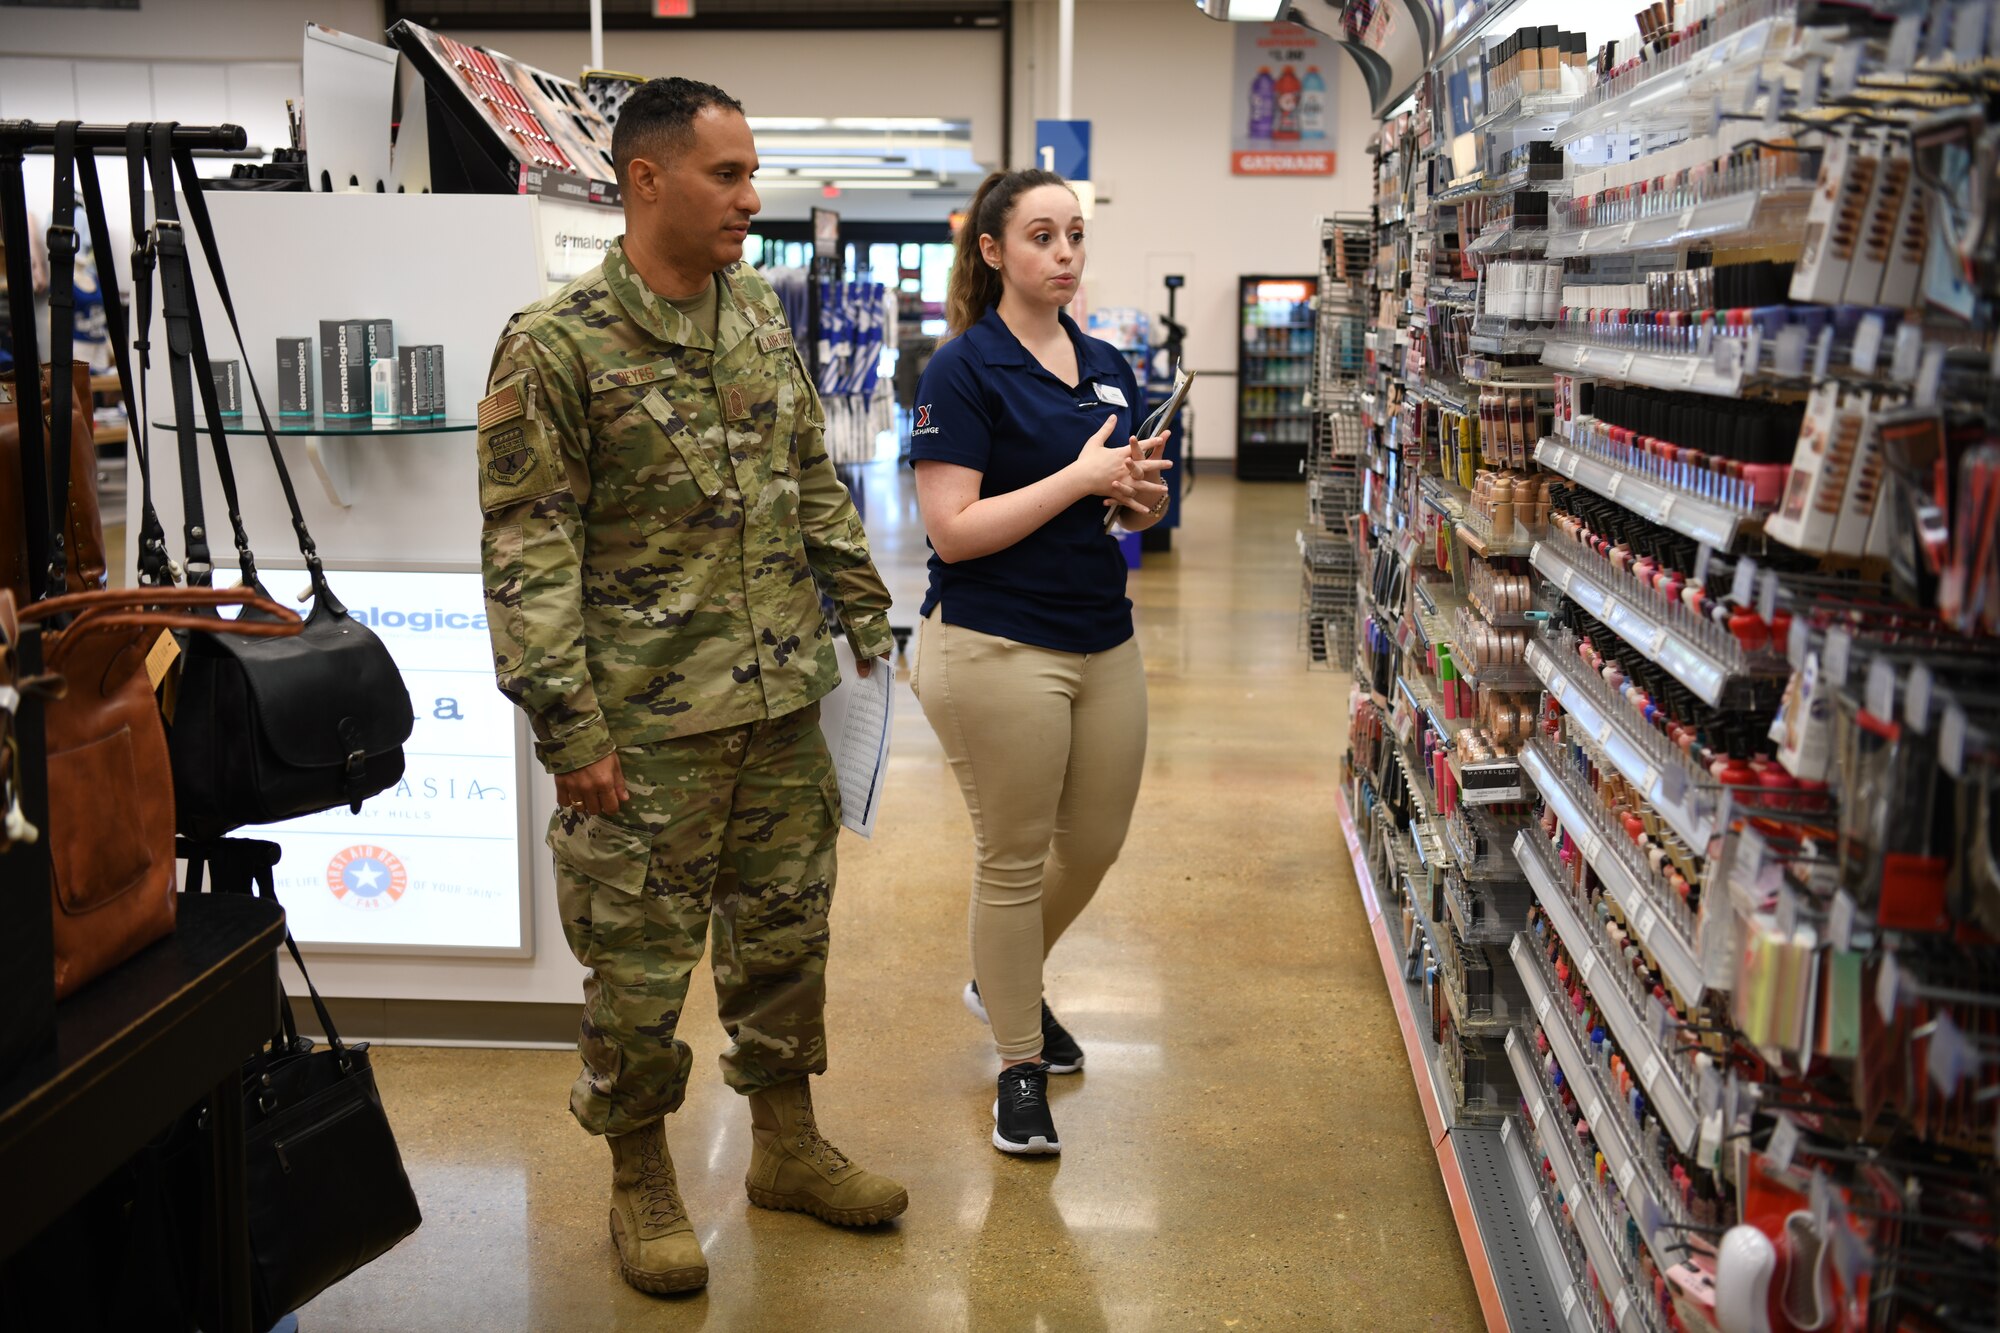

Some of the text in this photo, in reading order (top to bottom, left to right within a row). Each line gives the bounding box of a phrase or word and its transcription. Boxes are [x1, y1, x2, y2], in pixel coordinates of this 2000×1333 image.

[1040, 146, 1055, 172] 1
[1240, 155, 1328, 171] GATORADE
[555, 232, 612, 252] dermalog
[297, 342, 307, 411] dermalogica
[338, 325, 349, 413] dermalogica
[618, 367, 656, 384] REYES
[410, 351, 418, 415] dermalogica
[912, 427, 940, 437] EXCHANGE
[389, 810, 432, 819] HILLS
[330, 845, 404, 894] FIRST AID BEAUTY
[277, 877, 320, 889] HE LIFE
[413, 880, 426, 890] OF
[432, 882, 462, 894] YOUR
